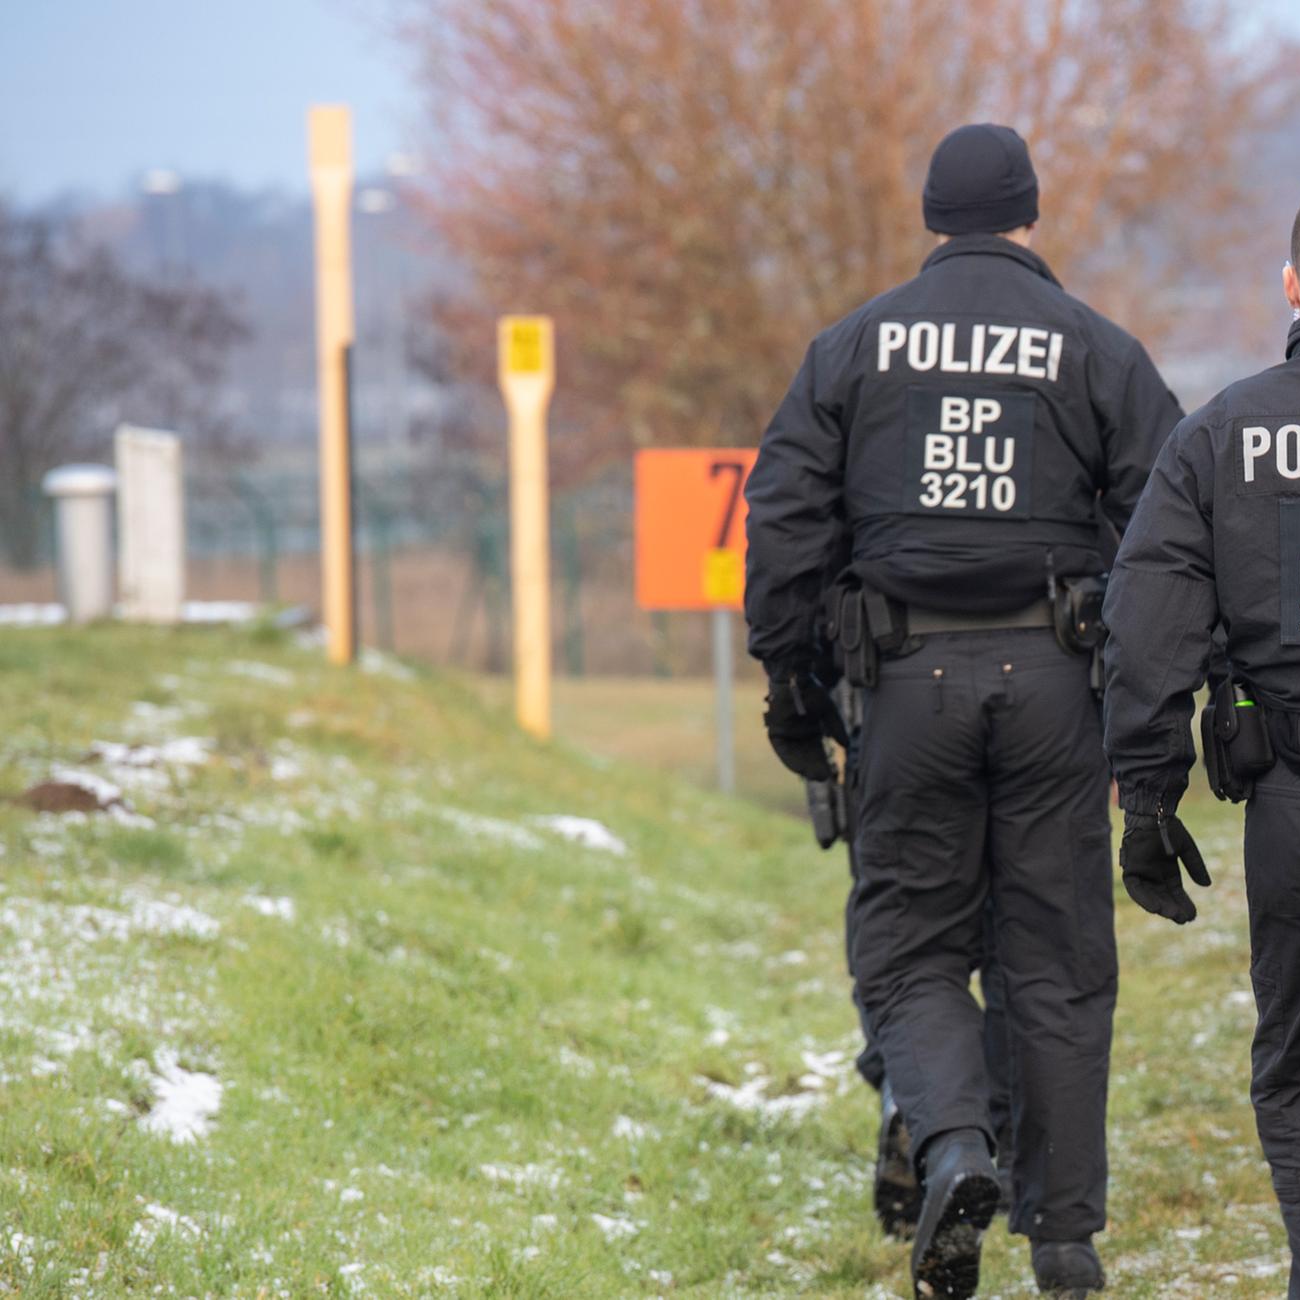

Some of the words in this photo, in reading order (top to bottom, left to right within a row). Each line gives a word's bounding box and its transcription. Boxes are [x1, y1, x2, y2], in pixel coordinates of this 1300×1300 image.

[876, 320, 1064, 382] POLIZEI
[940, 396, 1002, 435] BP
[923, 433, 1014, 473] BLU
[919, 471, 1016, 512] 3210
